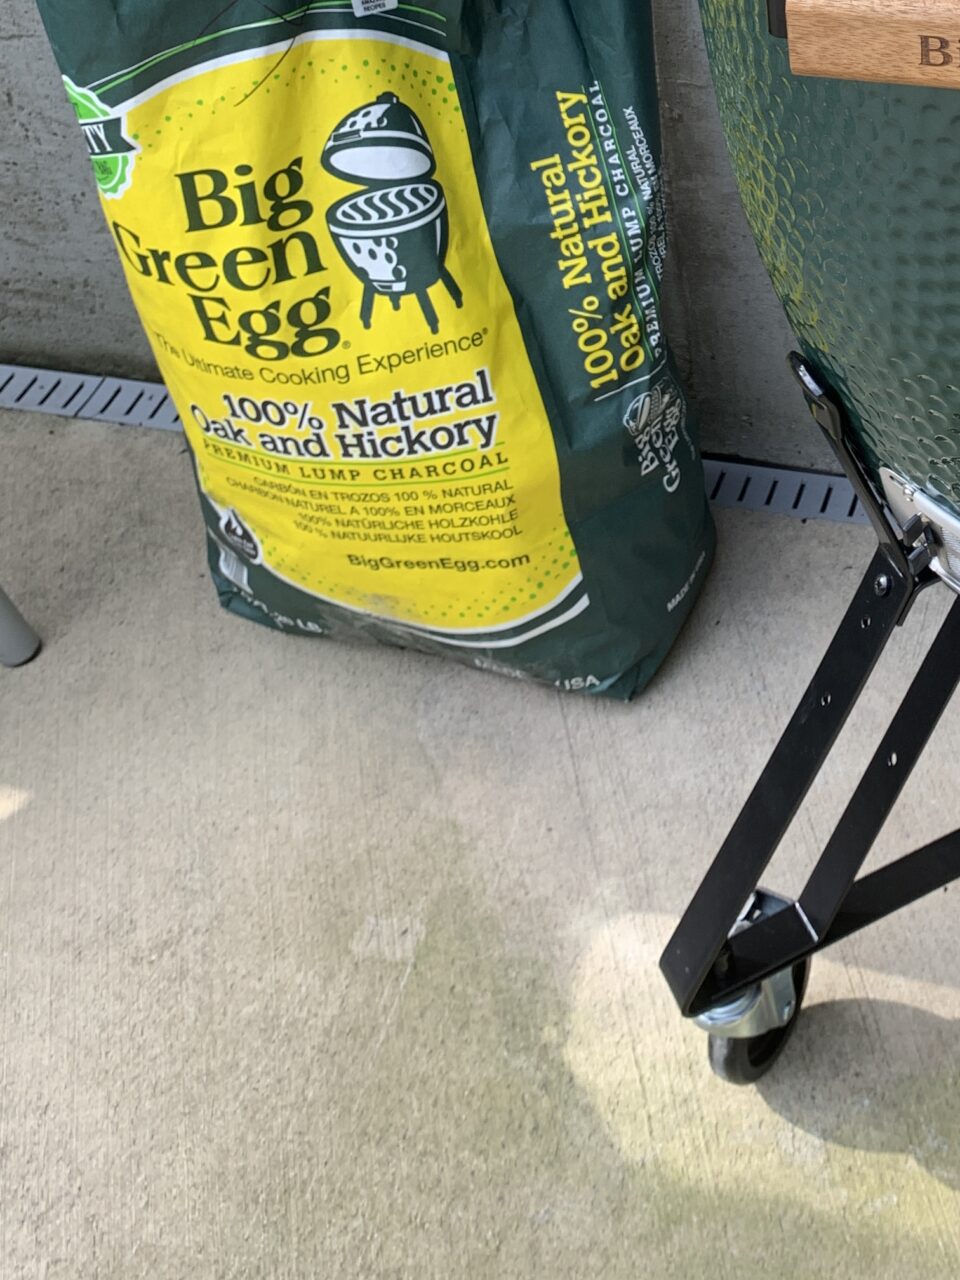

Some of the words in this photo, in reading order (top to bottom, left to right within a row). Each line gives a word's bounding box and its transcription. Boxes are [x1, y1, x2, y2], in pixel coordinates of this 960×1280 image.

[555, 90, 613, 229] Hickory
[588, 80, 630, 197] CHARCOAL
[622, 105, 656, 177] MORCEAUX
[174, 156, 314, 233] Big
[626, 145, 652, 201] NATURAL
[529, 153, 593, 290] Natural
[112, 220, 329, 293] Green
[587, 231, 629, 301] and
[154, 332, 181, 359] The
[182, 348, 254, 382] Ultimate
[258, 362, 350, 386] Cooking
[567, 294, 619, 390] 100%
[609, 302, 645, 372] Oak
[222, 393, 324, 430] 100%
[331, 368, 495, 430] Natural
[190, 404, 252, 446] Oak
[259, 430, 331, 459] and
[337, 413, 499, 460] Hickory
[203, 441, 291, 476] PREMIUM
[299, 464, 361, 482] LUMP
[373, 451, 510, 481] CHARCOAL
[634, 426, 659, 476] Big
[649, 414, 681, 493] Green
[309, 489, 329, 501] EN
[331, 491, 390, 503] TROZOS
[394, 491, 420, 502] 100
[442, 479, 515, 500] NATURAL
[362, 506, 401, 517] 100%
[404, 505, 425, 517] EN
[428, 494, 517, 515] MORCEAUX
[428, 508, 519, 530] HOLZKOHLE
[347, 553, 531, 572] BigGreenEgg.com
[429, 525, 523, 544] HOUTSKOOL
